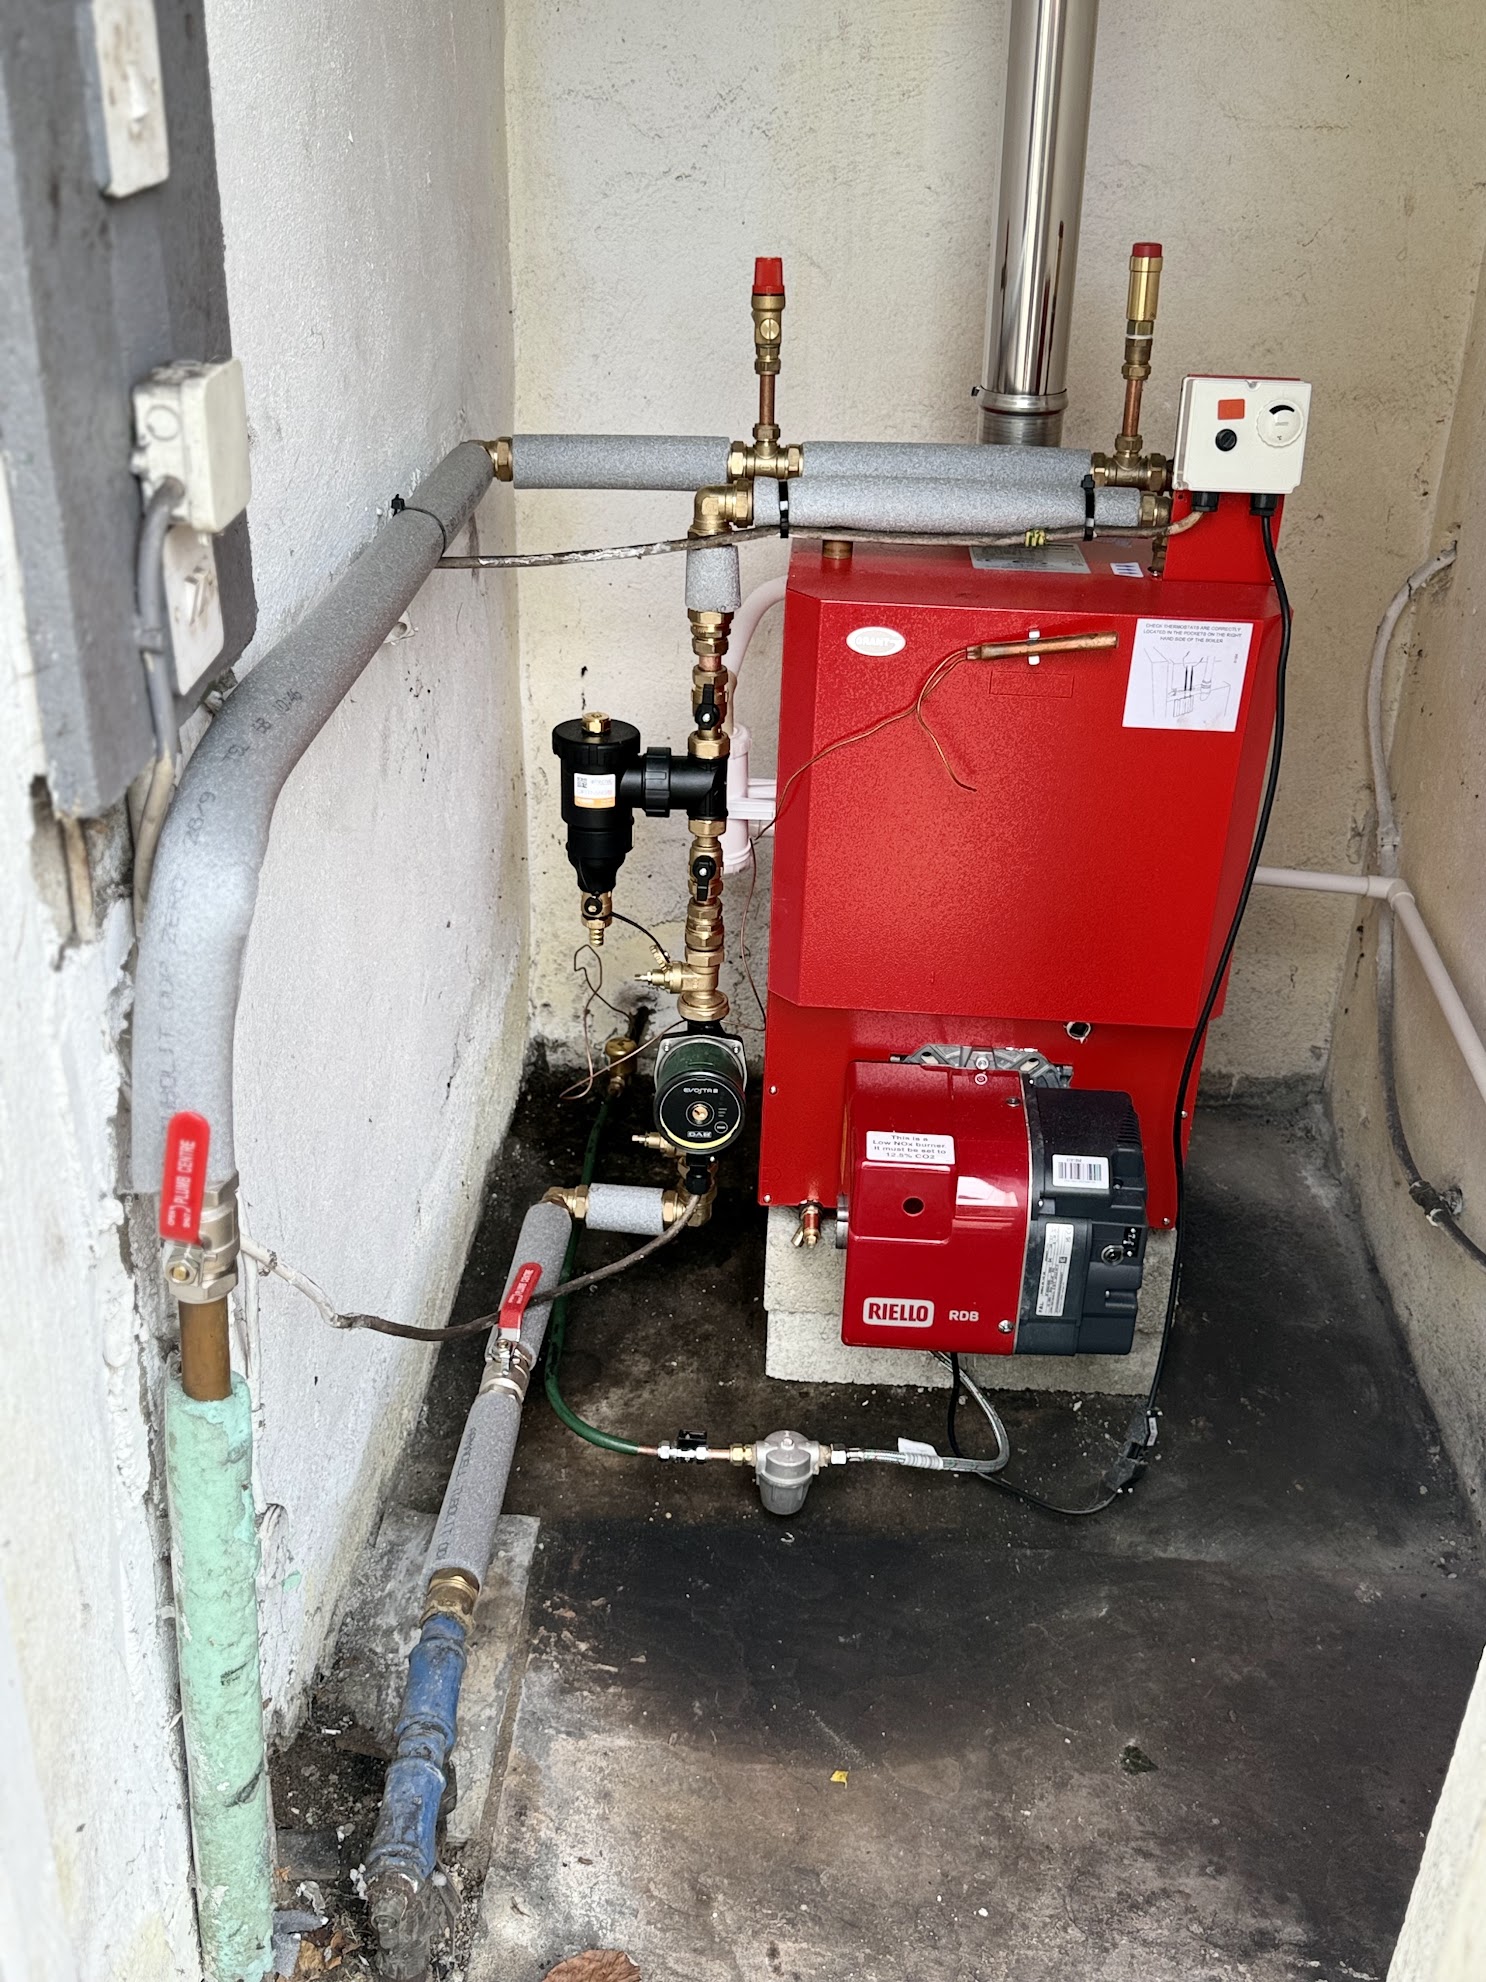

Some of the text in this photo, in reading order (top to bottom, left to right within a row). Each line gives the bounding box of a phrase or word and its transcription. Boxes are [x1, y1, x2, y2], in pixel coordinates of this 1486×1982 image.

[173, 1138, 197, 1205] PLUMB CENTRE
[867, 1303, 929, 1323] RIELLO
[949, 1310, 979, 1322] RDB
